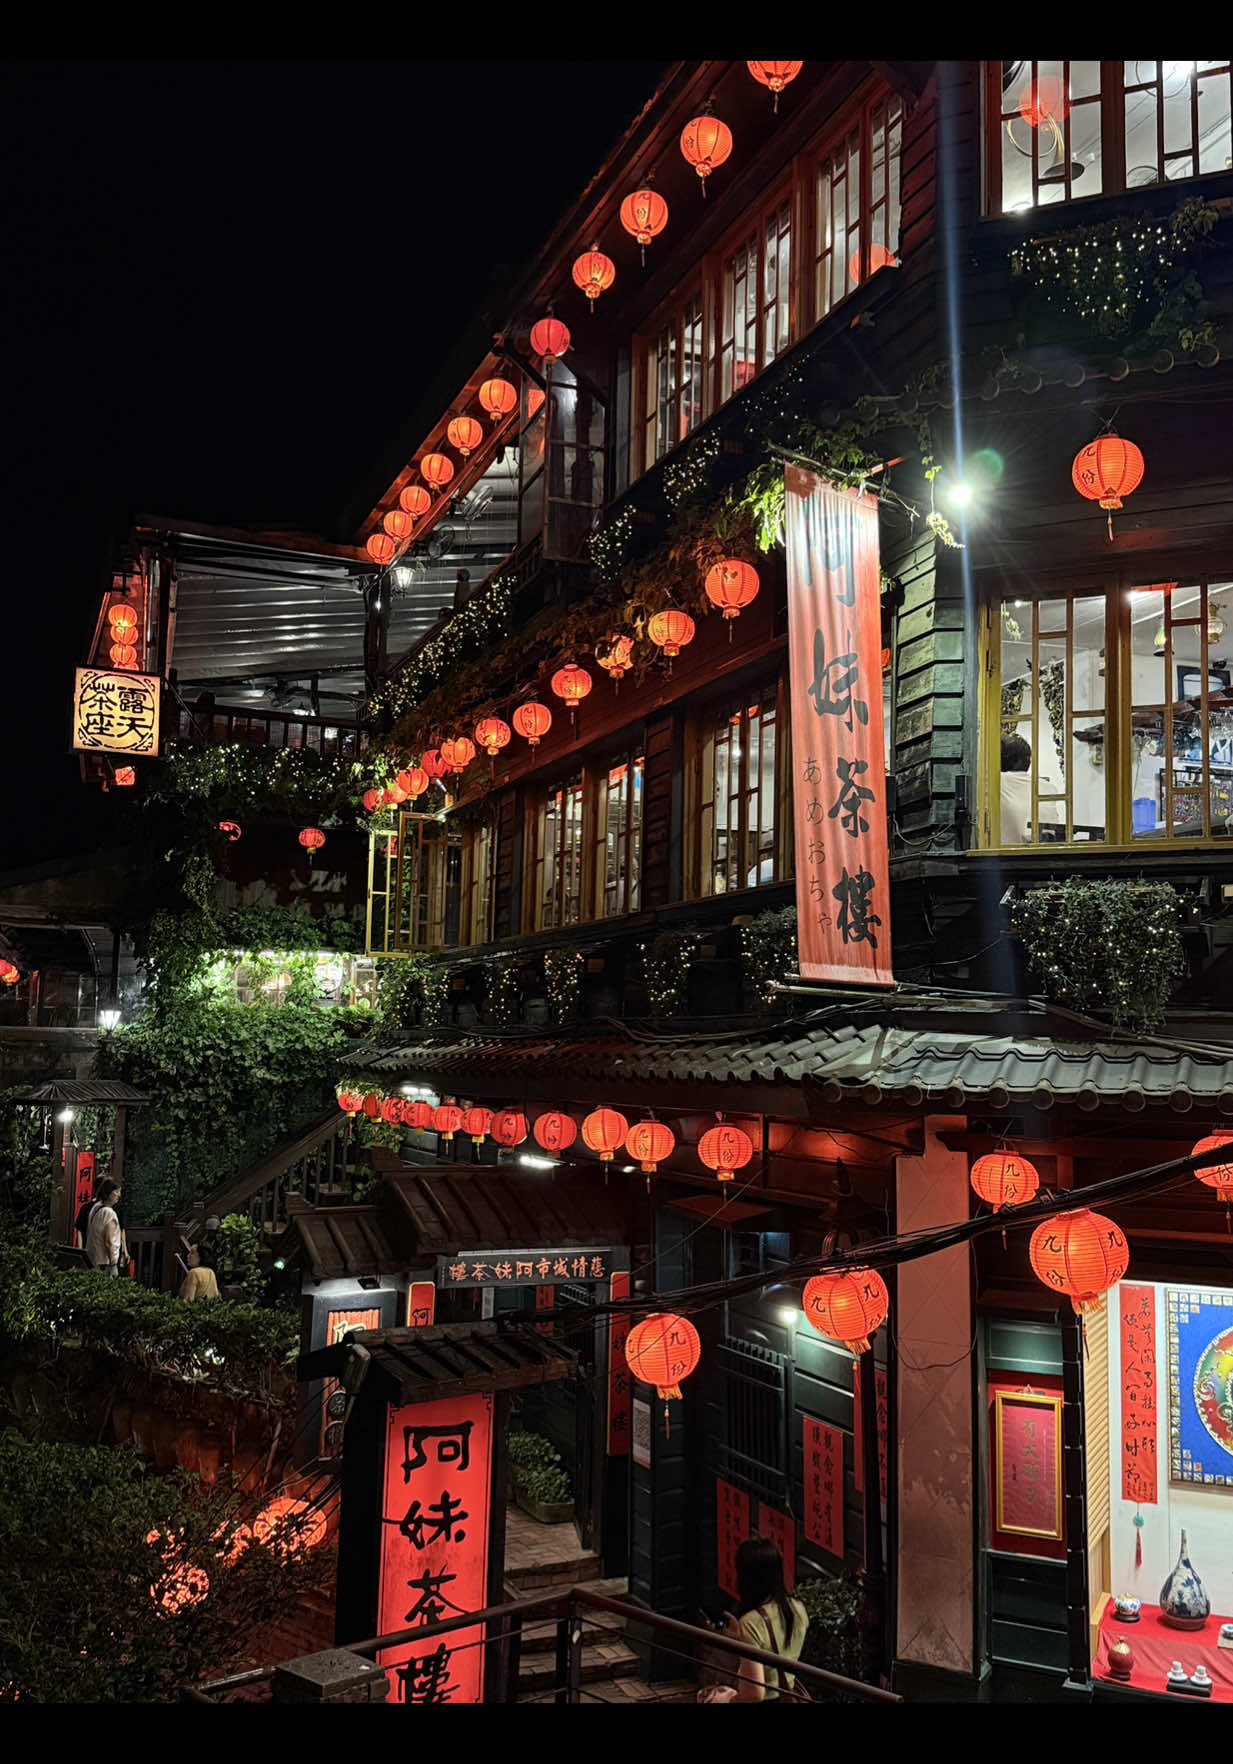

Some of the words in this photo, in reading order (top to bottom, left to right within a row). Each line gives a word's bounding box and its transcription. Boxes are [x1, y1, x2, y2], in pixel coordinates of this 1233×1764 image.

[1081, 445, 1096, 485] 九份
[82, 683, 117, 738] 茶座
[117, 686, 151, 739] 露天
[721, 1131, 735, 1164] 九份
[1004, 1162, 1020, 1199] 九份
[449, 1255, 606, 1282] 悲情城市阿妹茶樓
[1043, 1235, 1067, 1287] 九份
[670, 1332, 687, 1377] 九份
